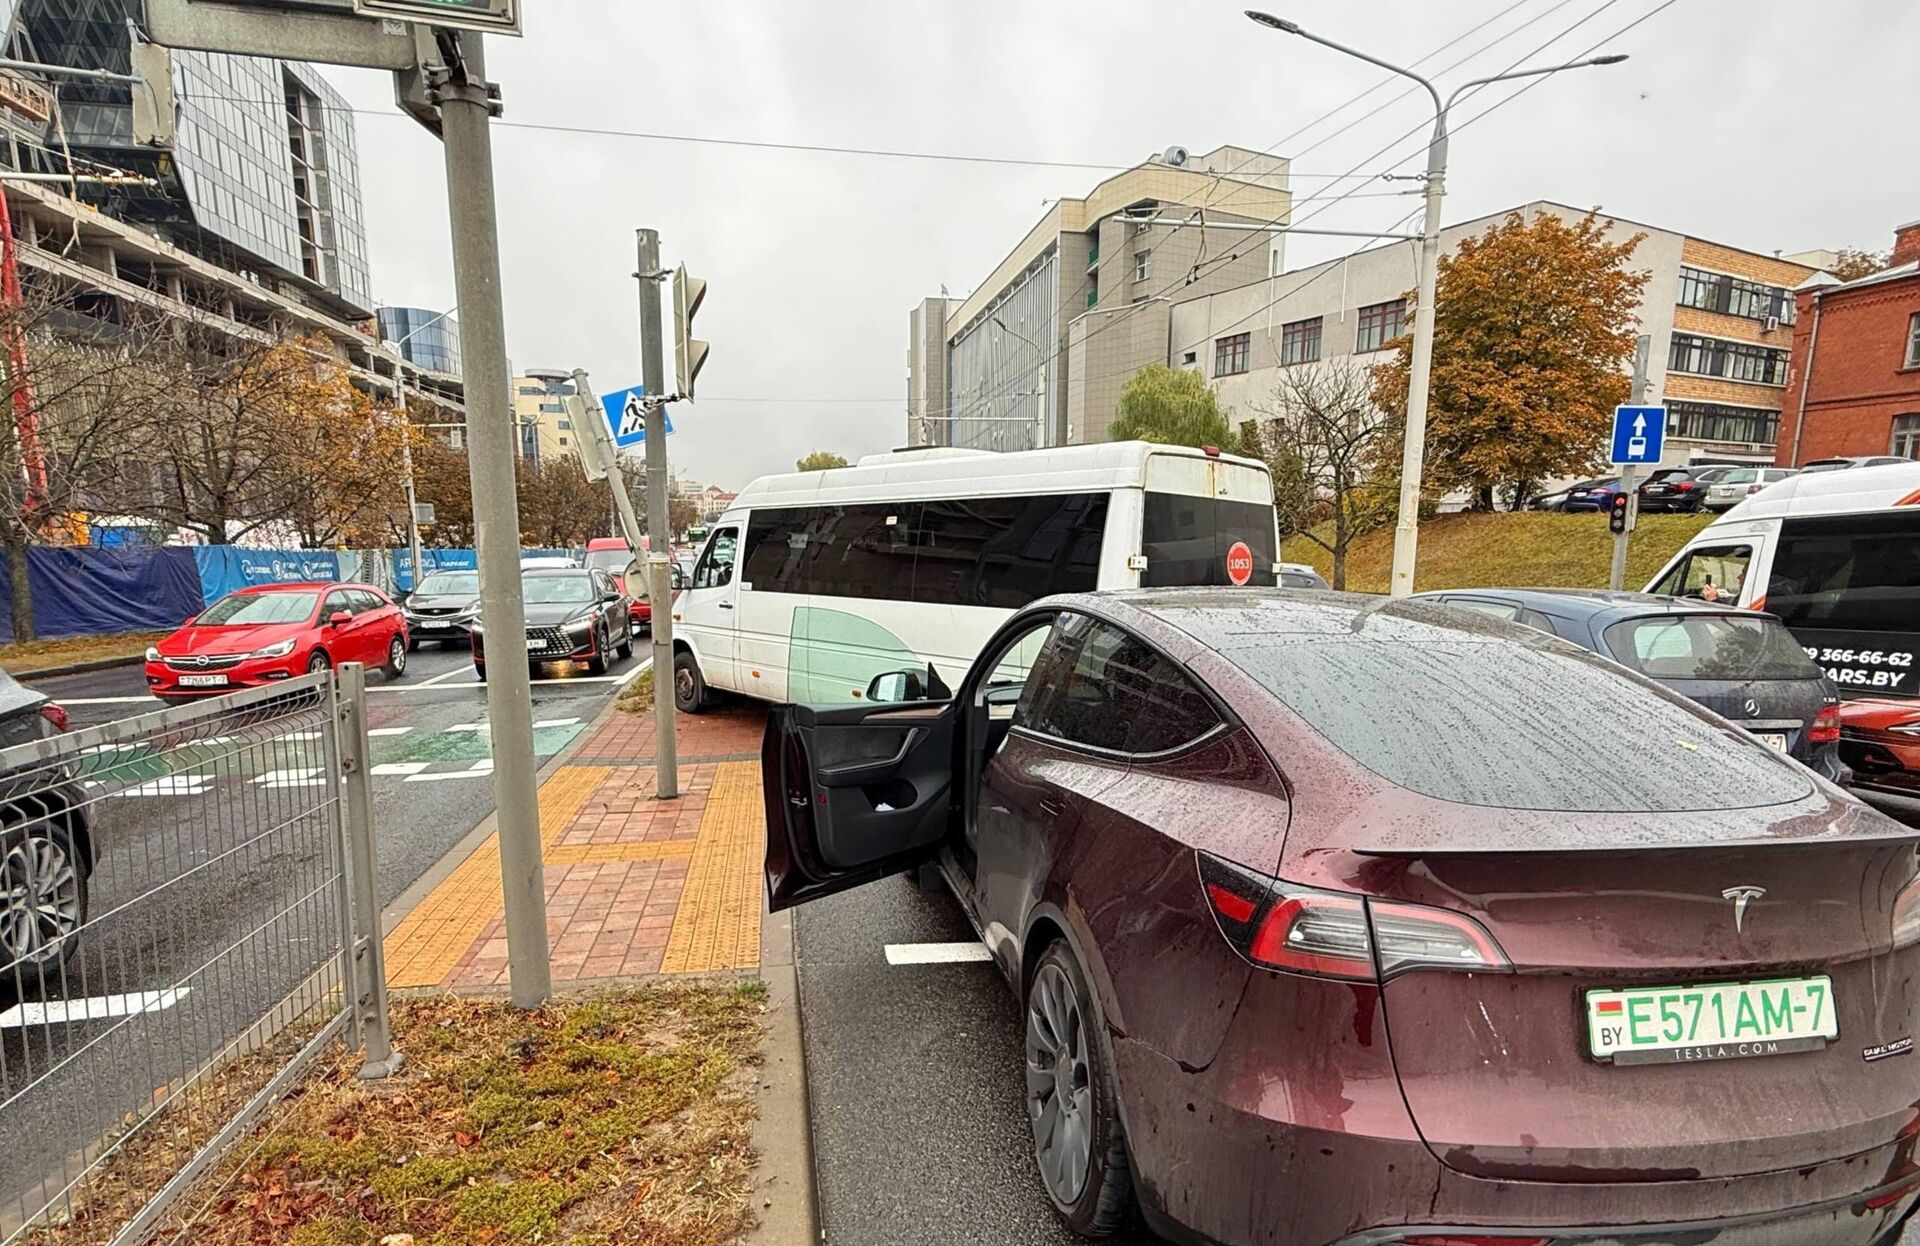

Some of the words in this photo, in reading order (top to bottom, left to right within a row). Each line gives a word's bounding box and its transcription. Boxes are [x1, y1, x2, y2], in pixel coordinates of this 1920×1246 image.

[1230, 558, 1250, 570] 1053
[1820, 648, 1913, 667] 366-66-62
[1627, 985, 1825, 1044] E571AM-7
[1601, 1027, 1622, 1046] BY
[1674, 1043, 1779, 1060] TESLA.COM
